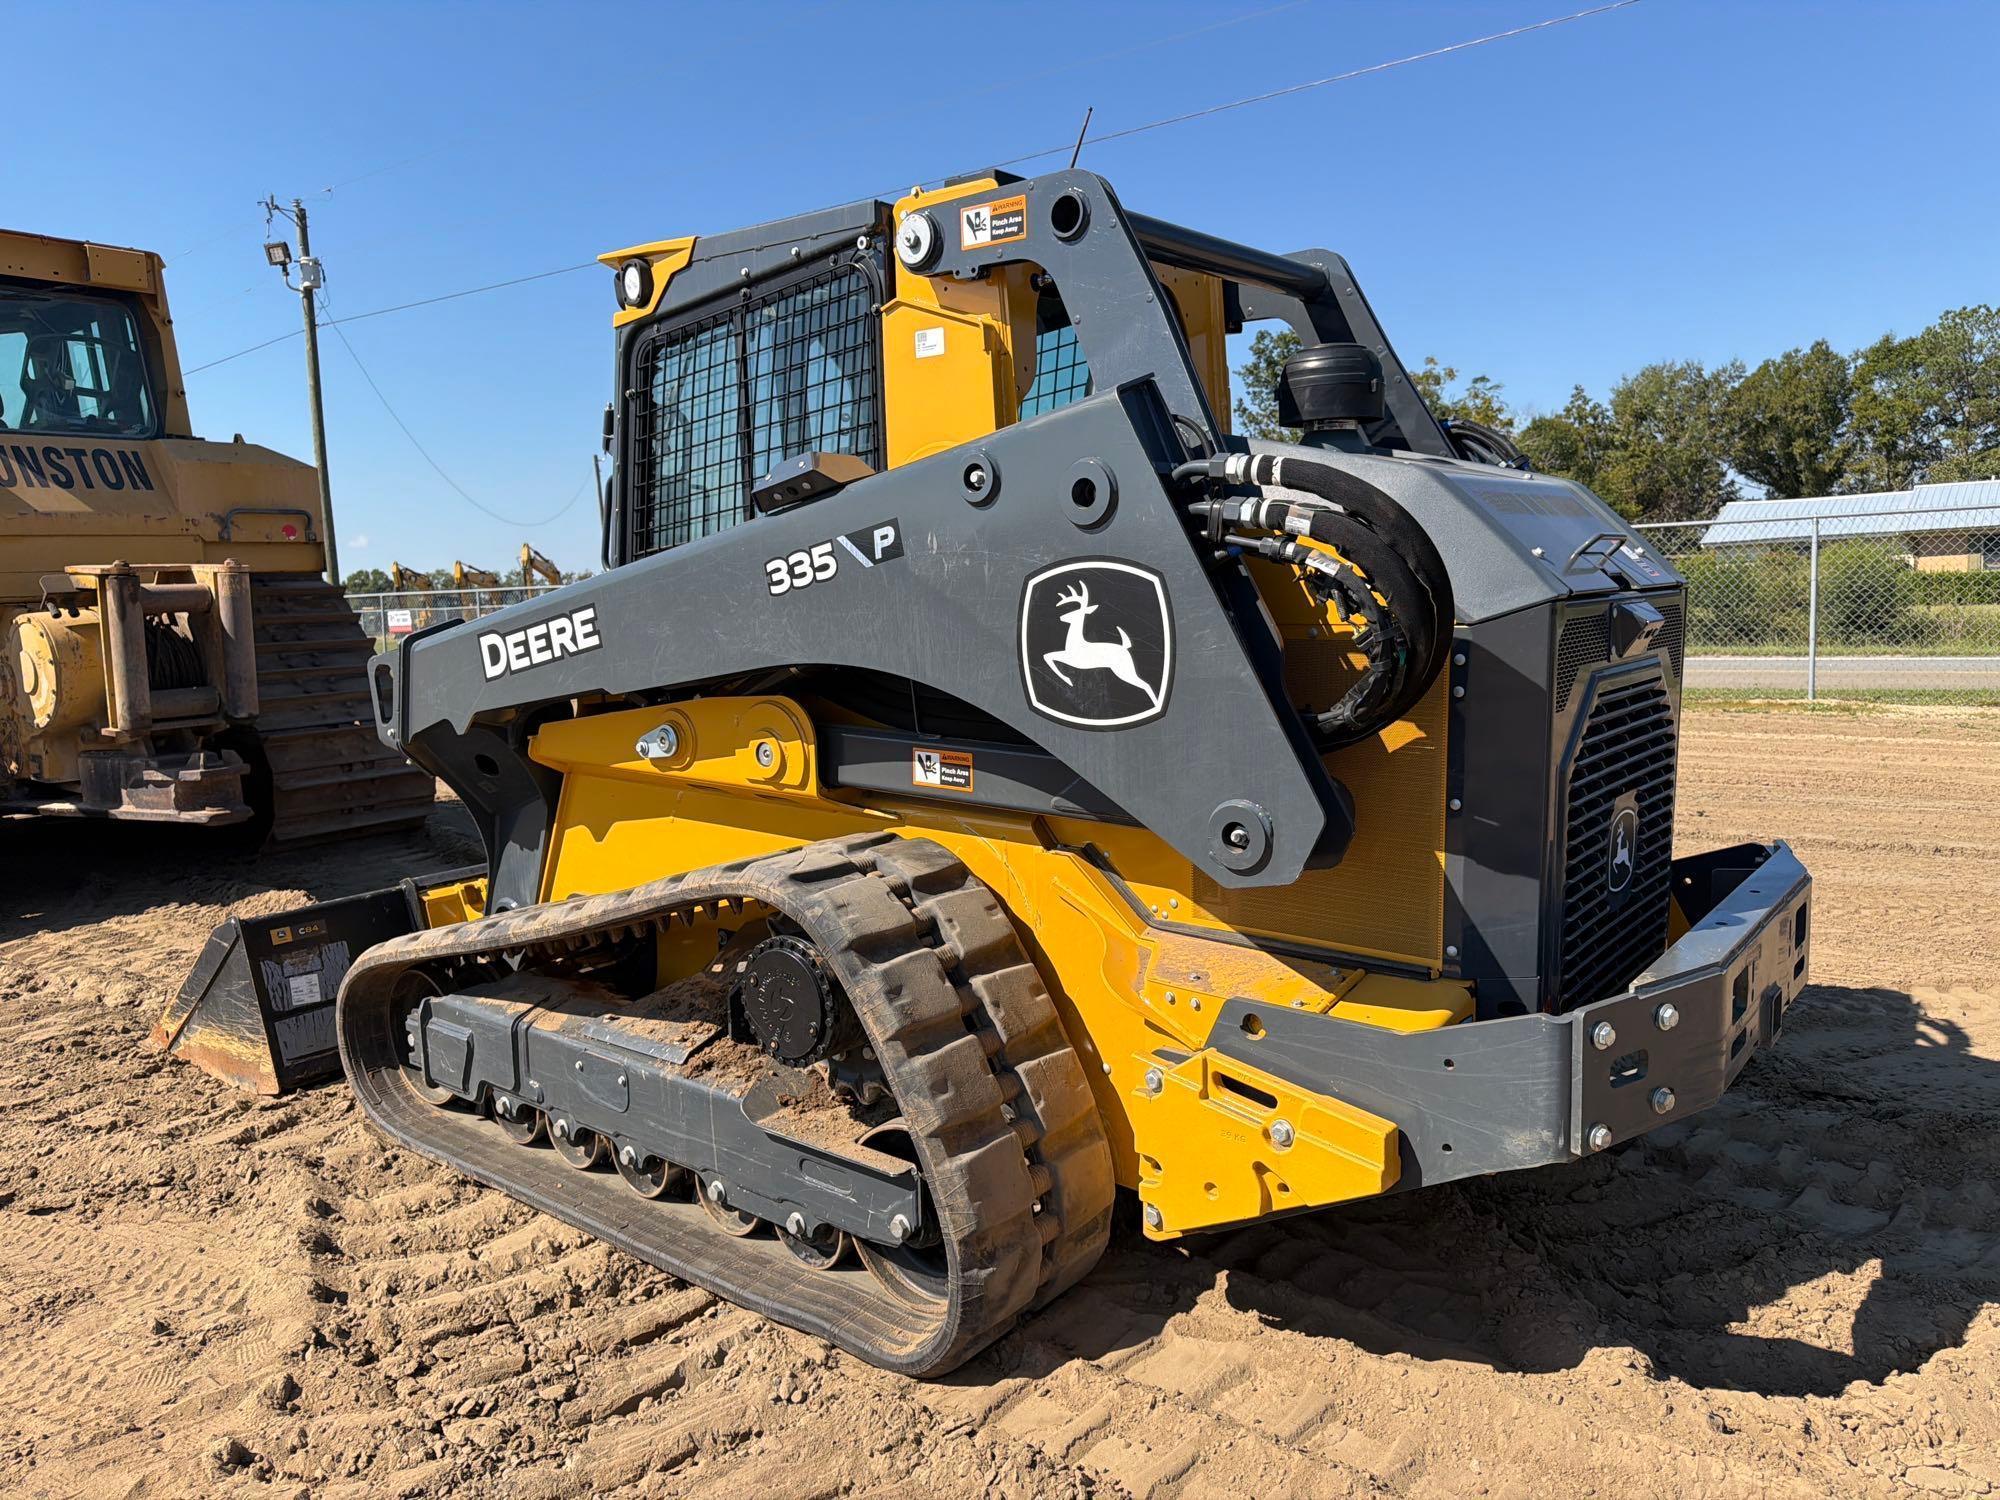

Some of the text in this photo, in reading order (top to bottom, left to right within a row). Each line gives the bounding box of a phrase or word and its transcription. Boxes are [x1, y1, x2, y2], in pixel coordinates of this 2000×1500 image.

[998, 199, 1023, 210] WARNING
[992, 215, 1022, 227] Pinch Area
[992, 228, 1004, 236] Keep
[765, 542, 838, 595] 335
[479, 607, 600, 679] DEERE
[945, 755, 970, 763] WARNING
[941, 766, 969, 777] Pinch Area
[298, 924, 319, 935] C84
